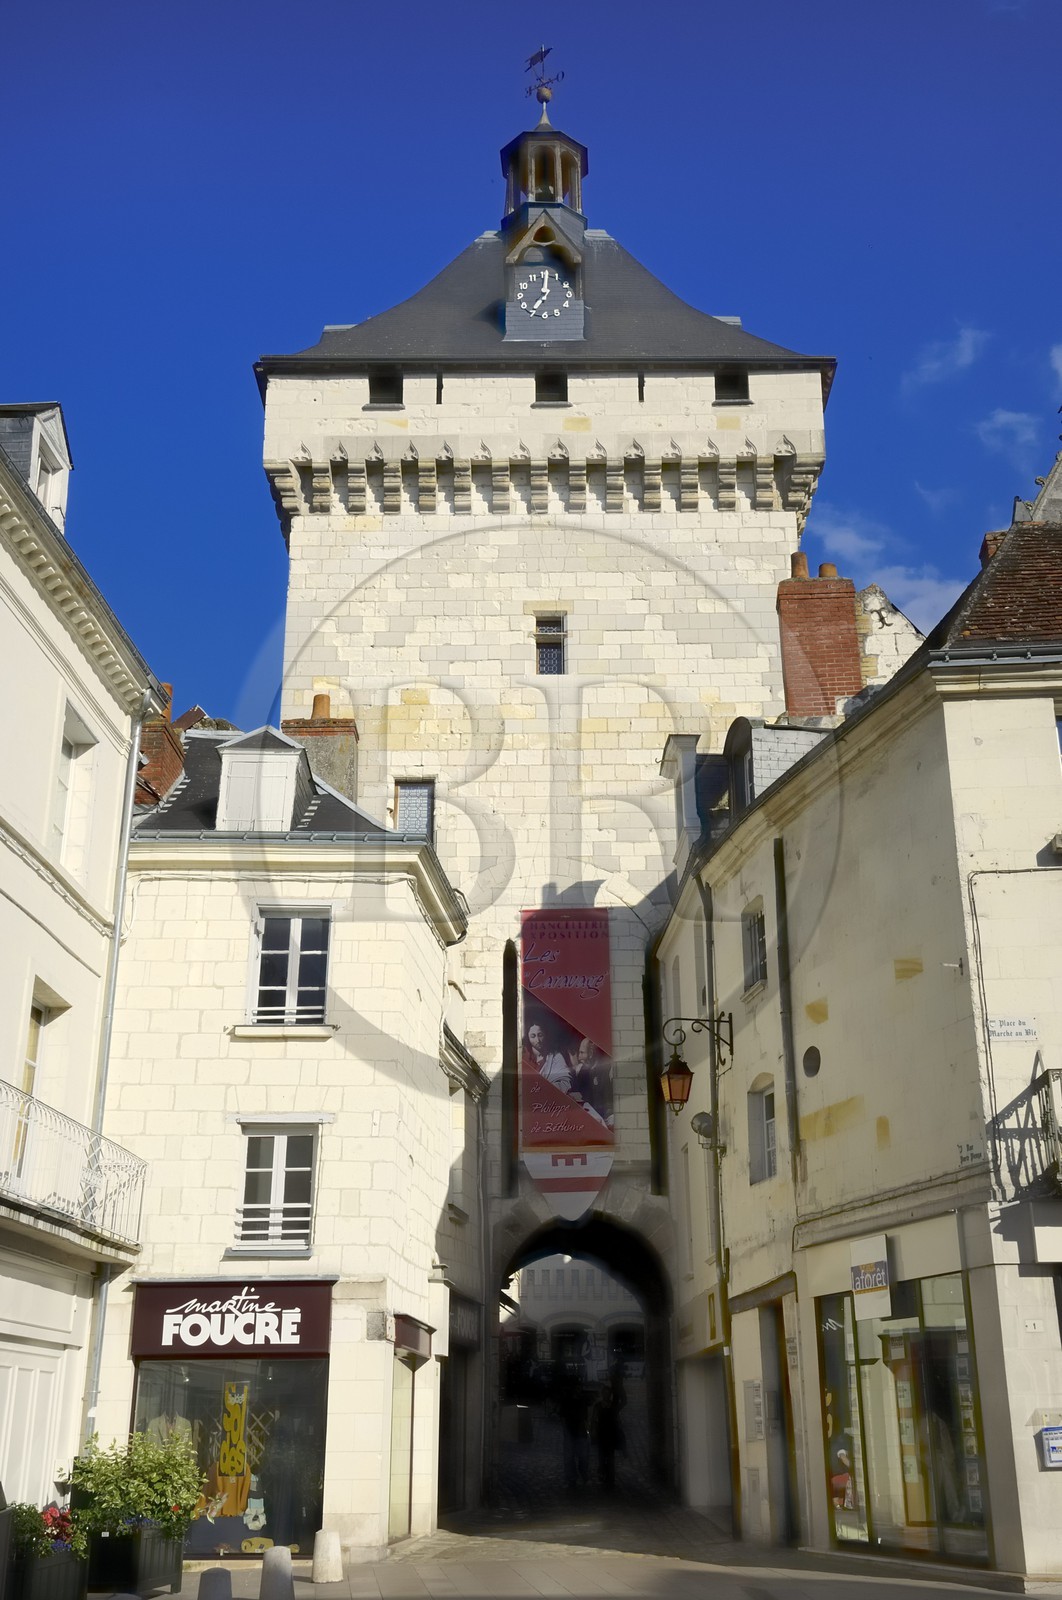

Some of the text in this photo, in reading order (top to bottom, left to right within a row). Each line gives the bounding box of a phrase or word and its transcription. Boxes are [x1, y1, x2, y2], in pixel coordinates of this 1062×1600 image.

[529, 274, 537, 282] 11
[519, 282, 528, 290] 10
[516, 292, 524, 300] 9
[562, 300, 570, 308] 4
[529, 309, 536, 318] 7
[541, 311, 549, 319] 6
[553, 308, 561, 317] 5
[523, 942, 560, 963] Les
[998, 1019, 1016, 1029] Place
[530, 1082, 541, 1093] de
[532, 1099, 571, 1117] Philippe
[530, 1122, 541, 1134] de
[851, 1267, 887, 1291] laforêt
[165, 1286, 281, 1317] martine
[161, 1307, 301, 1347] FOUCRÉ
